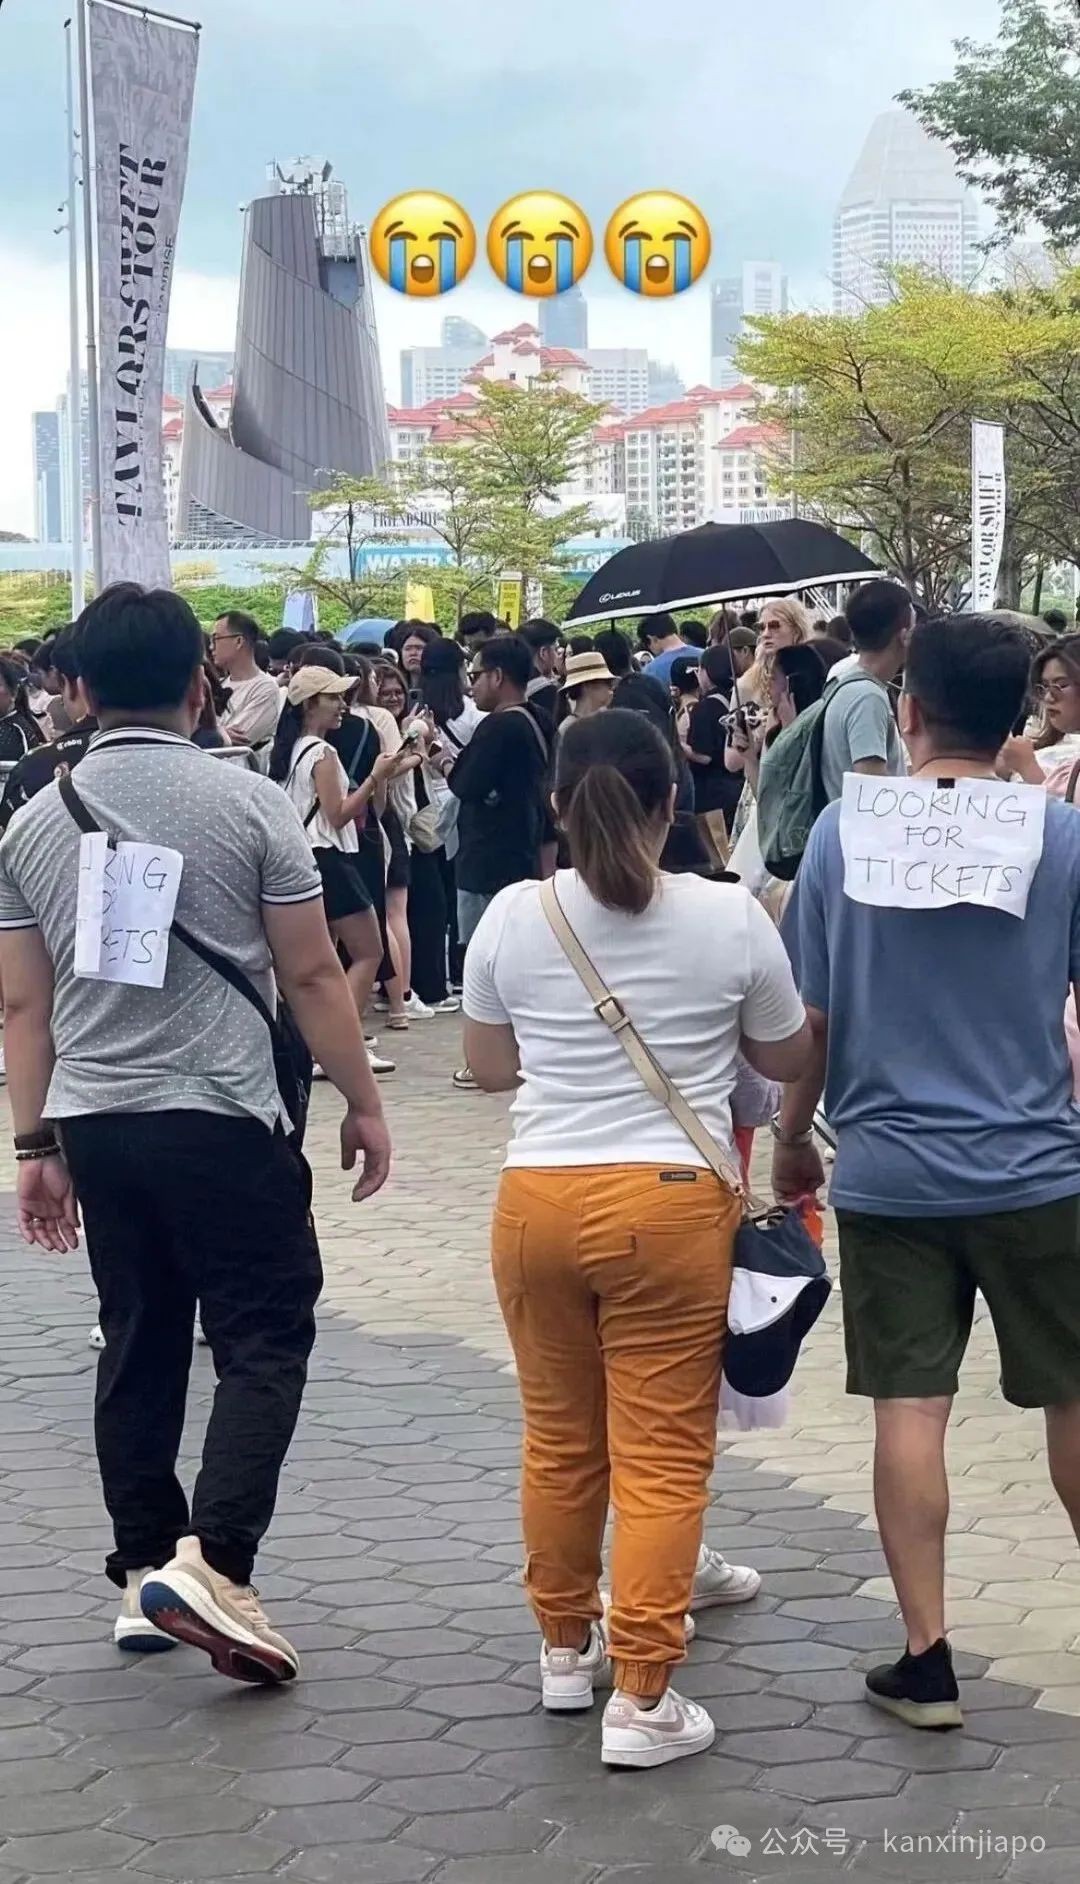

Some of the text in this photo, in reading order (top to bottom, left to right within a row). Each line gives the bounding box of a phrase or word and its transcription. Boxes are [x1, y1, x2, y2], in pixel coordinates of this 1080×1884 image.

[133, 158, 167, 284] TOUR
[978, 471, 996, 526] SWIFT
[611, 589, 641, 601] LEXUS
[857, 784, 1027, 826] LOOKING
[904, 825, 964, 848] FOR
[854, 856, 1022, 897] TICKETS
